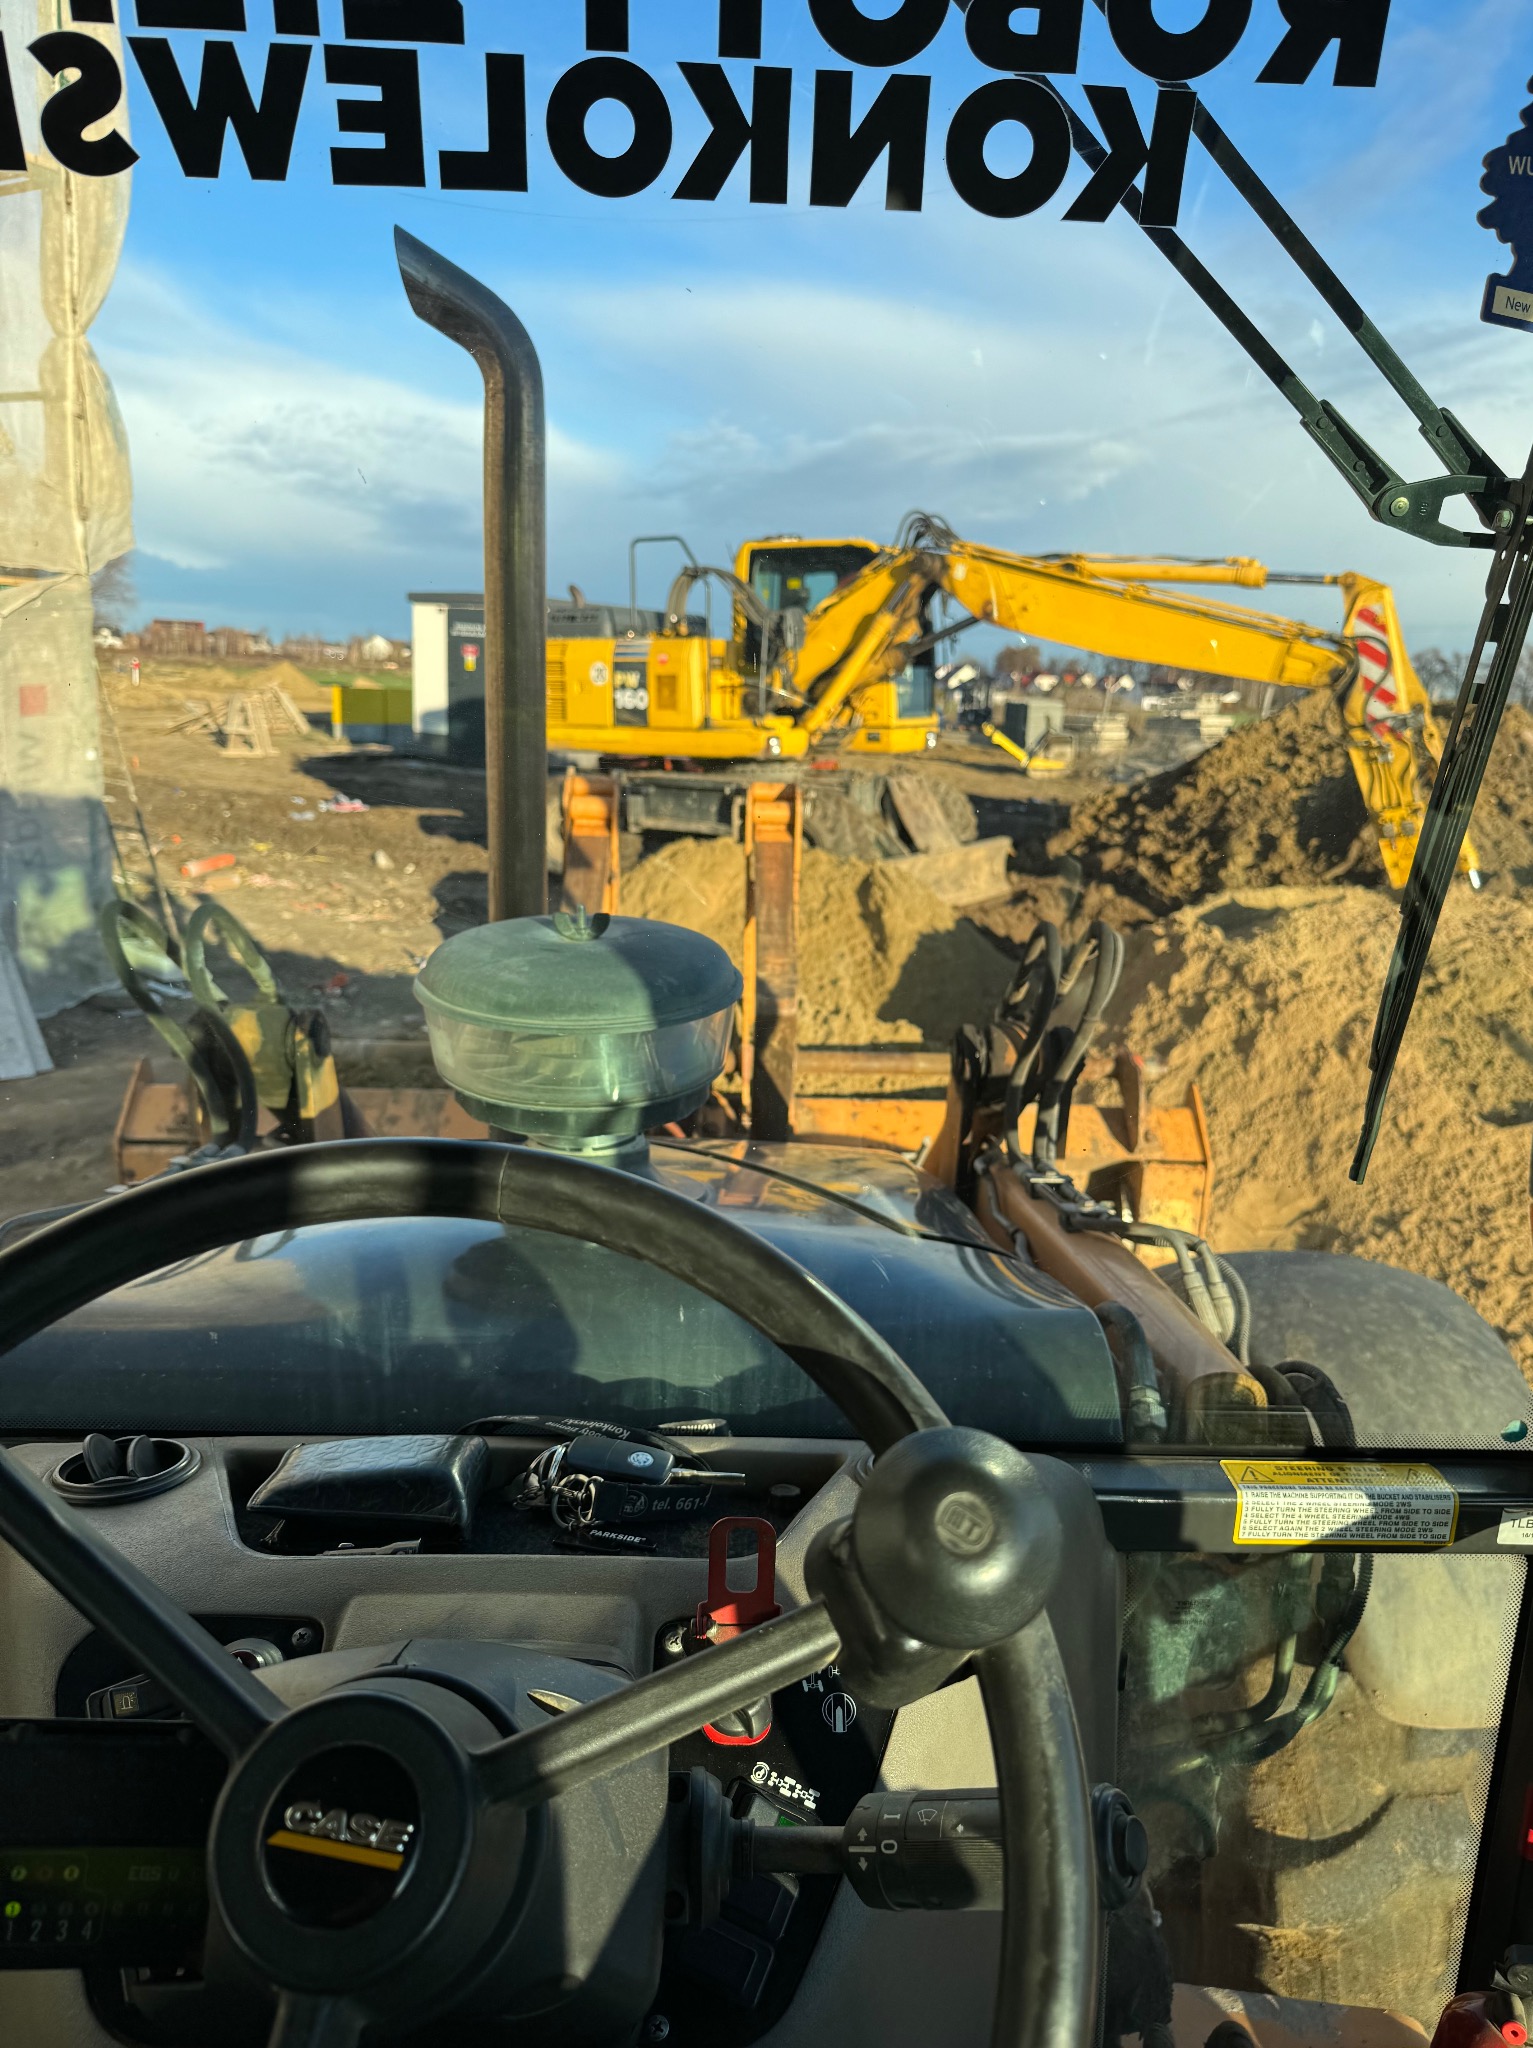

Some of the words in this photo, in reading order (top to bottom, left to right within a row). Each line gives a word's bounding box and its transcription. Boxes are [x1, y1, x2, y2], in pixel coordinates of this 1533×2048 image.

[1505, 296, 1531, 314] New
[559, 1418, 631, 1440] Konkolewski
[652, 1497, 671, 1511] tel.
[284, 1801, 415, 1852] CASE
[29, 1919, 42, 1942] 2
[55, 1919, 69, 1942] 3
[81, 1919, 93, 1941] 4
